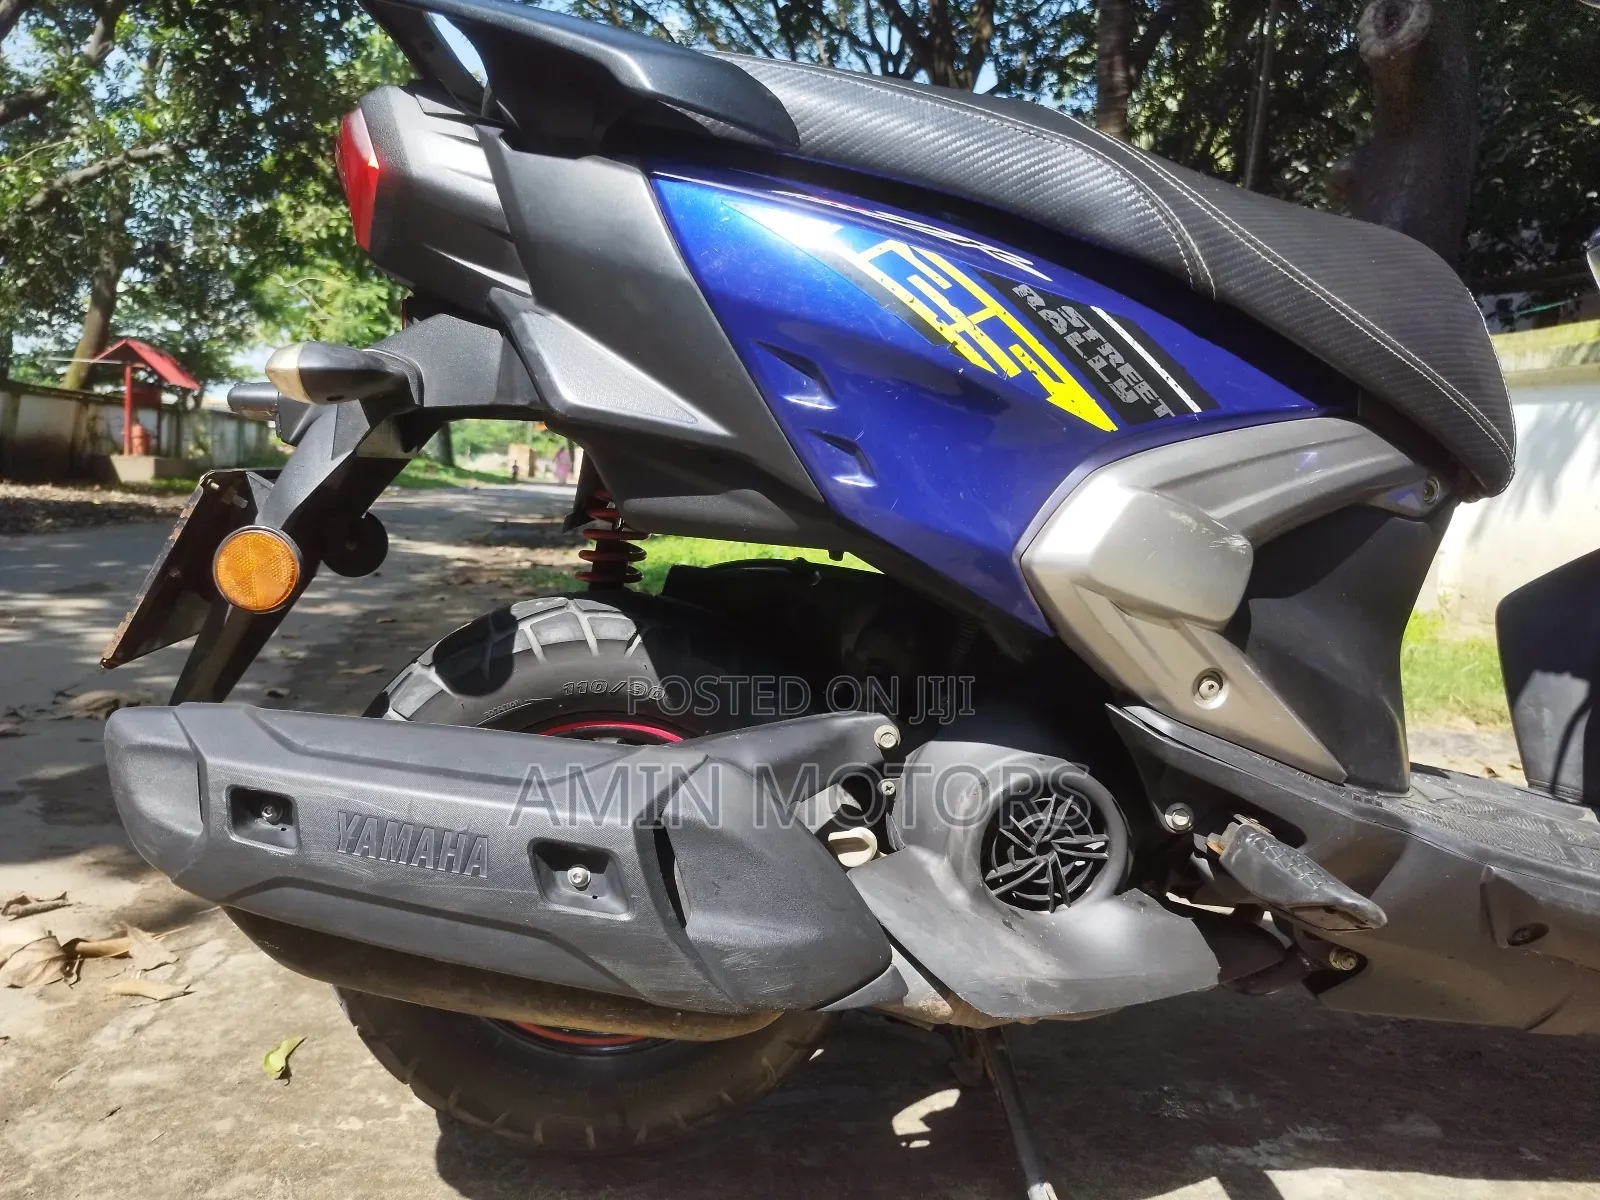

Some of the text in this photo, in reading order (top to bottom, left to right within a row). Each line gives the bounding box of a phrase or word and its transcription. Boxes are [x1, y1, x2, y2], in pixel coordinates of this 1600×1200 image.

[1011, 283, 1140, 404] RALLY
[1056, 305, 1176, 418] STREET
[337, 810, 490, 879] YAMAHA
